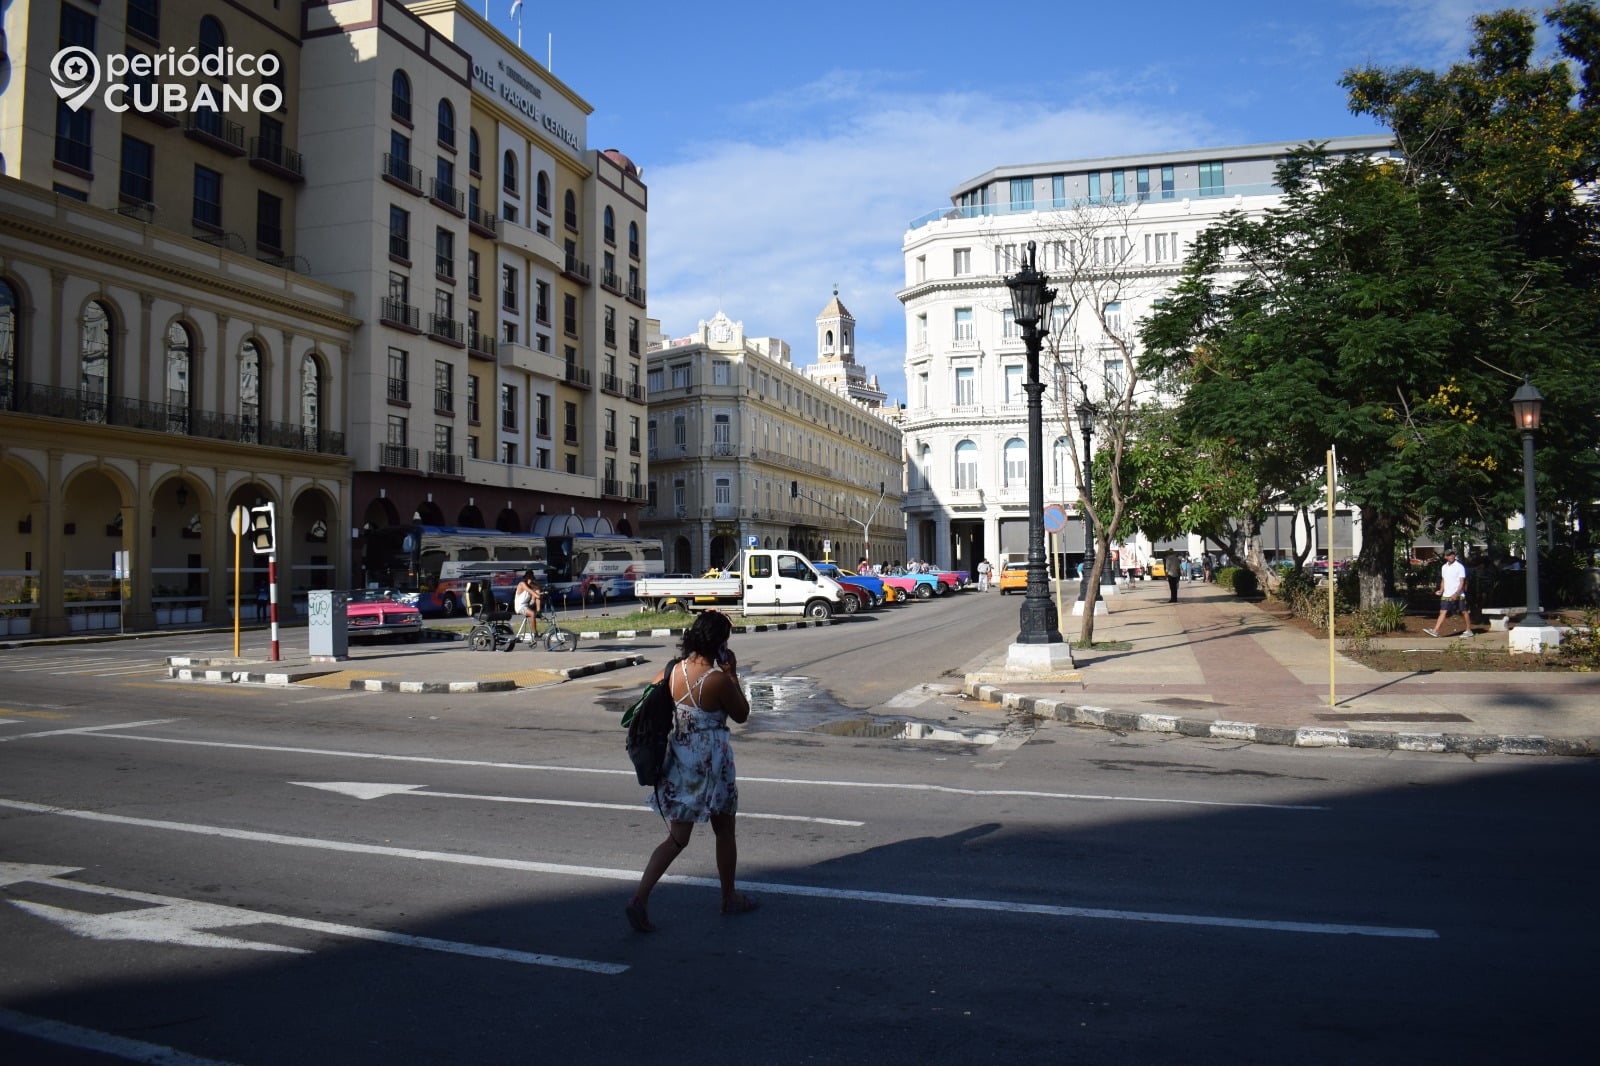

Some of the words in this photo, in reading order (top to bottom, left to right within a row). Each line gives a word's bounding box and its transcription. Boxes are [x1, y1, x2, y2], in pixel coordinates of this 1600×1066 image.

[472, 63, 496, 92] OTEL
[501, 82, 539, 121] PARQUE
[543, 113, 580, 151] CENTRAL
[748, 536, 757, 546] P
